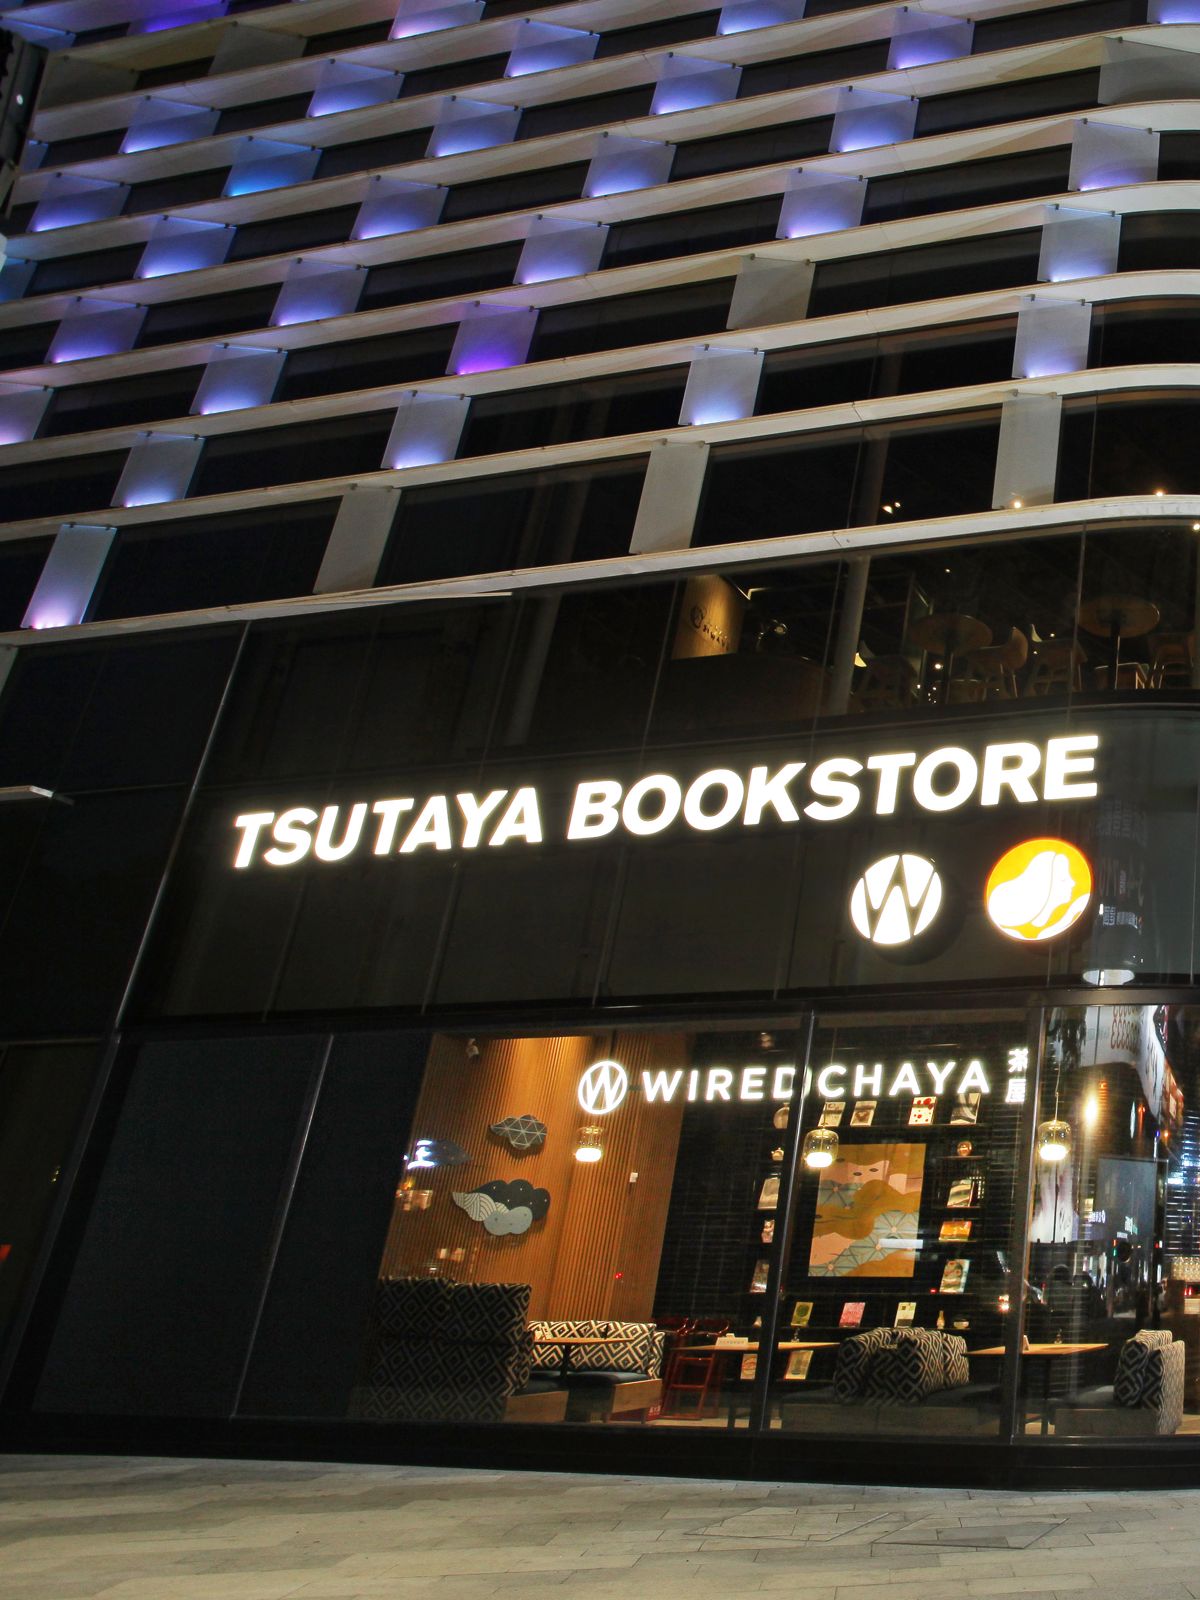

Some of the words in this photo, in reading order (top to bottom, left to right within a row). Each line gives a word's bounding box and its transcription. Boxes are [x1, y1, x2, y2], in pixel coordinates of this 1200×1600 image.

[234, 787, 543, 869] TSUTAYA
[567, 734, 1099, 840] BOOKSTORE
[642, 1066, 812, 1103] WIRED
[817, 1059, 990, 1099] CHAYA
